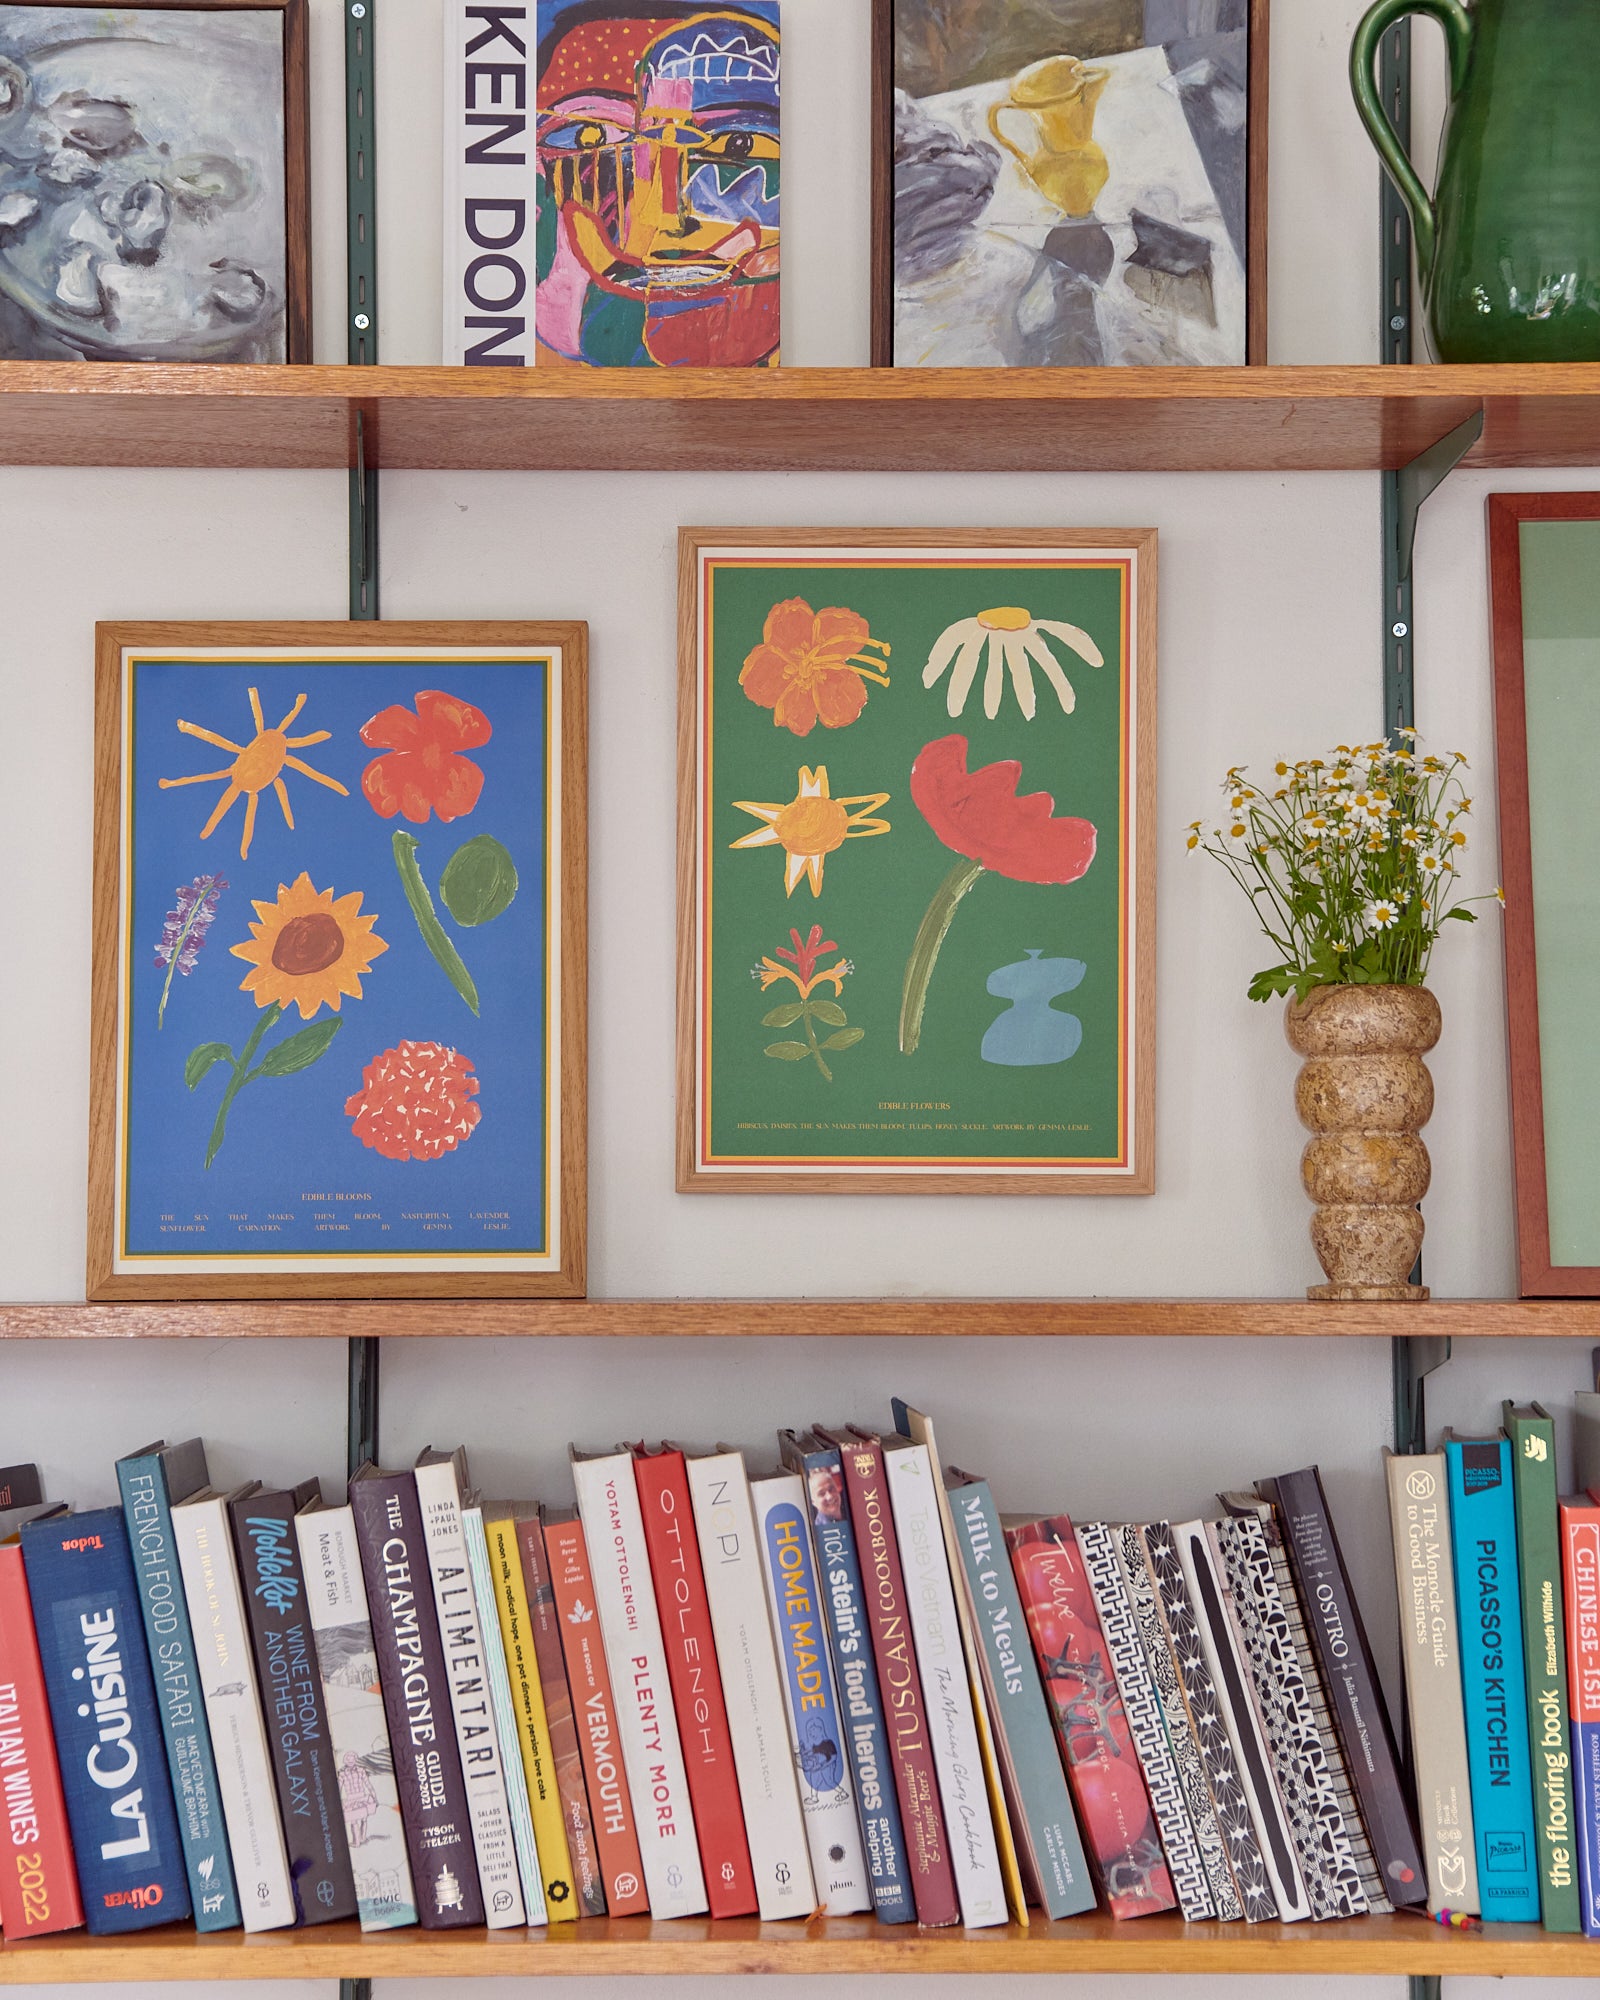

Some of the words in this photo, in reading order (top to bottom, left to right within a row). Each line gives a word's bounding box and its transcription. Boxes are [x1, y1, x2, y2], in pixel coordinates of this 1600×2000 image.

[465, 6, 526, 164] KEN
[464, 198, 526, 366] DON
[878, 1102, 908, 1110] EDIBLE
[910, 1102, 951, 1110] FLOWERS
[160, 1214, 175, 1222] THE
[194, 1214, 209, 1222] SUN
[228, 1213, 248, 1221] THAT
[267, 1213, 295, 1221] MAKES
[313, 1213, 336, 1221] THEM
[301, 1193, 333, 1201] EDIBLE
[335, 1192, 372, 1201] BLOOMS
[129, 1474, 167, 1566] FRENCH
[385, 1494, 403, 1530] THE
[427, 1501, 455, 1513] LINDA
[432, 1525, 459, 1537] JONES
[708, 1480, 741, 1564] NOPI
[961, 1495, 992, 1566] Milk
[1407, 1505, 1418, 1520] to
[1423, 1504, 1437, 1537] The
[195, 1526, 209, 1549] THE
[319, 1533, 331, 1567] Meat
[496, 1533, 506, 1558] moon
[605, 1480, 622, 1530] YOTAM
[614, 1536, 639, 1631] OTTOLENGHI
[823, 1527, 849, 1566] rick
[864, 1487, 896, 1612] COOKBOOK
[910, 1506, 929, 1566] Taste
[1408, 1523, 1426, 1569] Good
[201, 1554, 217, 1593] BOOK
[325, 1569, 336, 1578] &
[326, 1580, 339, 1606] Fish
[774, 1520, 811, 1616] HOME
[979, 1569, 999, 1601] to
[1030, 1533, 1075, 1622] Twelve
[1424, 1541, 1444, 1613] Monocle
[146, 1570, 178, 1634] FOOD
[208, 1594, 220, 1610] OF
[505, 1585, 517, 1616] radical
[660, 1489, 717, 1763] OTTOLENGHI
[828, 1569, 862, 1654] stein's
[919, 1566, 947, 1656] Vietnam
[1316, 1583, 1349, 1659] OSTRO
[1411, 1575, 1428, 1645] Business
[1476, 1540, 1504, 1671] PICASSO'S
[1542, 1580, 1555, 1624] Wilhide
[214, 1633, 229, 1667] JOHN
[286, 1623, 310, 1678] WINE
[382, 1537, 437, 1746] CHAMPAGNE
[515, 1644, 523, 1662] one
[581, 1637, 590, 1652] THE
[584, 1652, 593, 1676] BOOK
[789, 1621, 826, 1712] MADE
[988, 1605, 1024, 1695] Meals
[1431, 1616, 1448, 1667] Guide
[1544, 1624, 1557, 1676] Elizabeth
[158, 1641, 195, 1728] SAFARI
[437, 1567, 497, 1779] ALIMENTARI
[516, 1663, 527, 1680] pot
[521, 1680, 532, 1716] dinners
[588, 1676, 595, 1687] OF
[843, 1658, 873, 1717] food
[879, 1616, 923, 1760] TUSCAN
[934, 1667, 950, 1695] The
[264, 1631, 295, 1729] ANOTHER
[281, 1731, 311, 1817] GALAXY
[294, 1680, 321, 1741] FROM
[739, 1623, 750, 1656] YOTAM
[745, 1658, 759, 1716] OTTOLENGHI
[756, 1725, 767, 1763] RAMAEL
[762, 1764, 773, 1799] SCULLY
[941, 1695, 959, 1762] Morning
[1086, 1702, 1100, 1734] COOK
[1096, 1739, 1110, 1773] BOOK
[1342, 1675, 1355, 1695] Julia
[1349, 1695, 1365, 1728] Busuttil
[1357, 1727, 1376, 1773] Nishimura
[1484, 1677, 1511, 1787] KITCHEN
[1538, 1688, 1562, 1747] book
[175, 1737, 194, 1796] GUILLAUME
[186, 1734, 202, 1770] MAEVE
[526, 1723, 539, 1758] persian
[534, 1758, 542, 1777] love
[585, 1692, 626, 1835] VERMOUTH
[631, 1655, 663, 1752] PLENTY
[649, 1765, 676, 1838] MORE
[853, 1723, 883, 1811] heroes
[3, 1769, 40, 1845] WINES
[414, 1752, 432, 1810] 2020-2021
[426, 1751, 446, 1808] GUIDE
[537, 1778, 546, 1800] cake
[903, 1762, 920, 1818] Alexander
[919, 1769, 931, 1802] Beer's
[951, 1762, 968, 1805] Glory
[1543, 1752, 1569, 1843] flooring
[100, 1788, 151, 1860] LA
[184, 1797, 201, 1840] BRAHIMI
[421, 1822, 456, 1837] TYSON
[477, 1808, 501, 1818] SALADS
[570, 1801, 584, 1829] Food
[922, 1803, 939, 1848] Maggie
[959, 1804, 985, 1871] Cookbook
[420, 1833, 462, 1849] STELZER
[575, 1829, 586, 1855] with
[867, 1819, 883, 1877] helping
[879, 1818, 897, 1877] another
[912, 1820, 930, 1875] Stephanie
[930, 1848, 941, 1863] &
[1043, 1826, 1057, 1861] CARLEY
[1051, 1861, 1066, 1897] MENDES
[1052, 1824, 1064, 1847] LUKA
[1060, 1847, 1074, 1885] MCCABE
[1546, 1846, 1570, 1888] the
[16, 1852, 50, 1925] 2022
[199, 1878, 221, 1890] SBS
[372, 1893, 401, 1905] CIVIC
[578, 1856, 593, 1900] feelings
[875, 1885, 901, 1897] BBC
[876, 1896, 903, 1907] BOOKS
